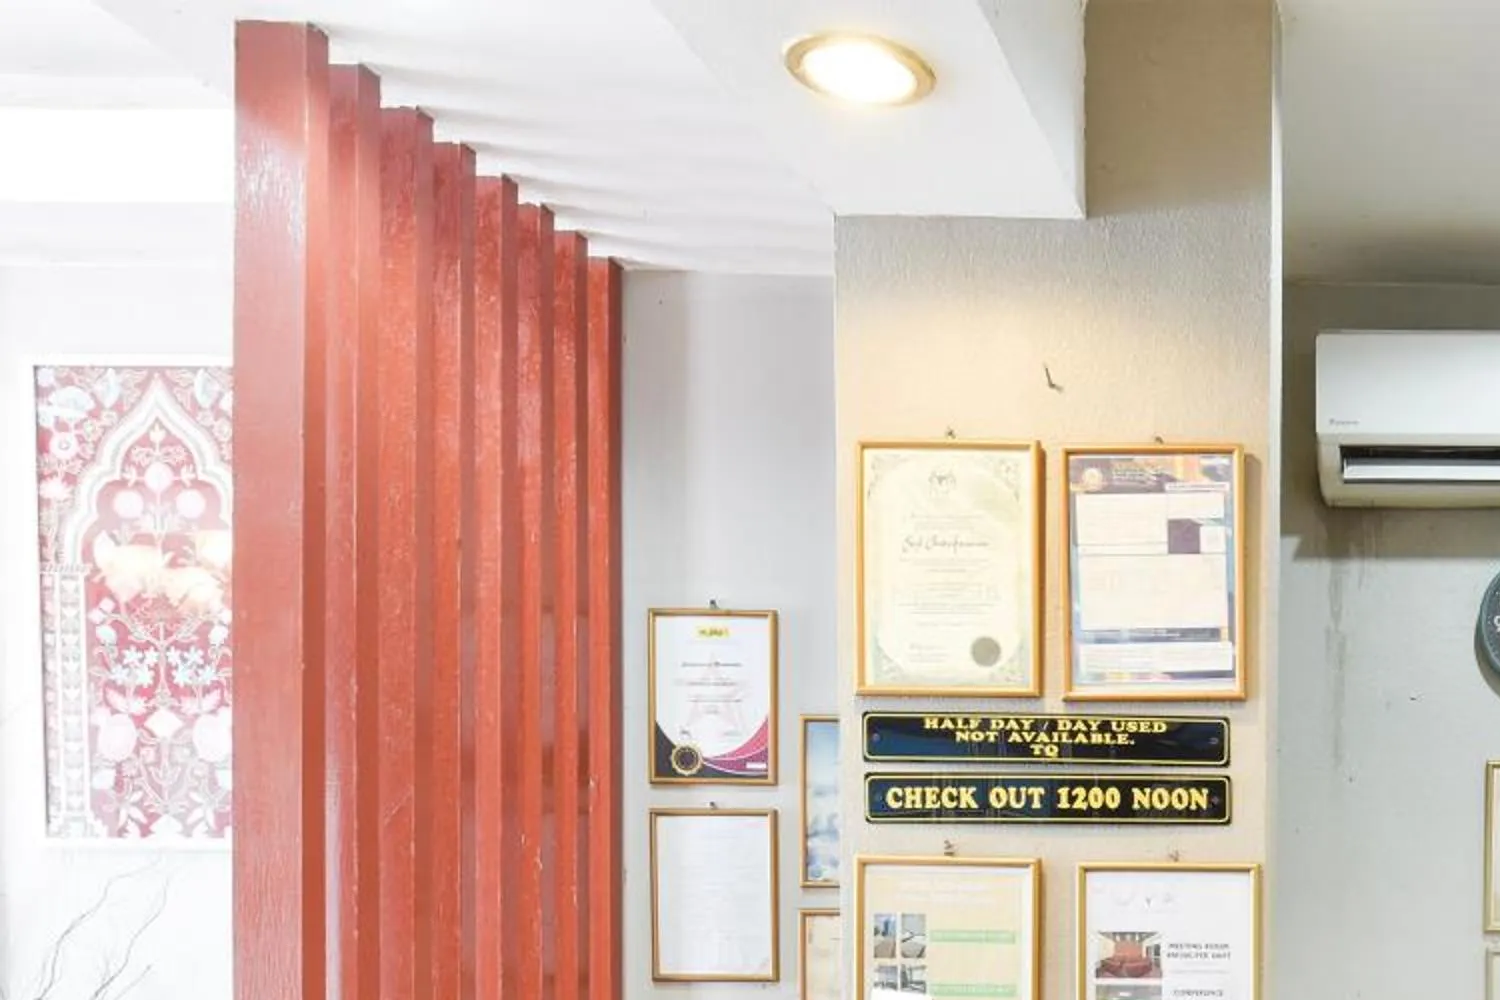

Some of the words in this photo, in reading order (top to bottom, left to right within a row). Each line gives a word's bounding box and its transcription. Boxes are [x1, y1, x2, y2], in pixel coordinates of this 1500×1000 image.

[924, 716, 982, 730] HALF
[990, 718, 1034, 731] DAY
[1058, 719, 1101, 732] DAY
[1111, 720, 1167, 733] USED
[955, 731, 999, 743] NOT
[1008, 732, 1135, 746] AVAILABLE.
[1030, 744, 1058, 757] TQ
[886, 787, 978, 809] CHECK
[989, 787, 1045, 809] OUT
[1057, 788, 1121, 810] 1200
[1132, 788, 1209, 810] NOON
